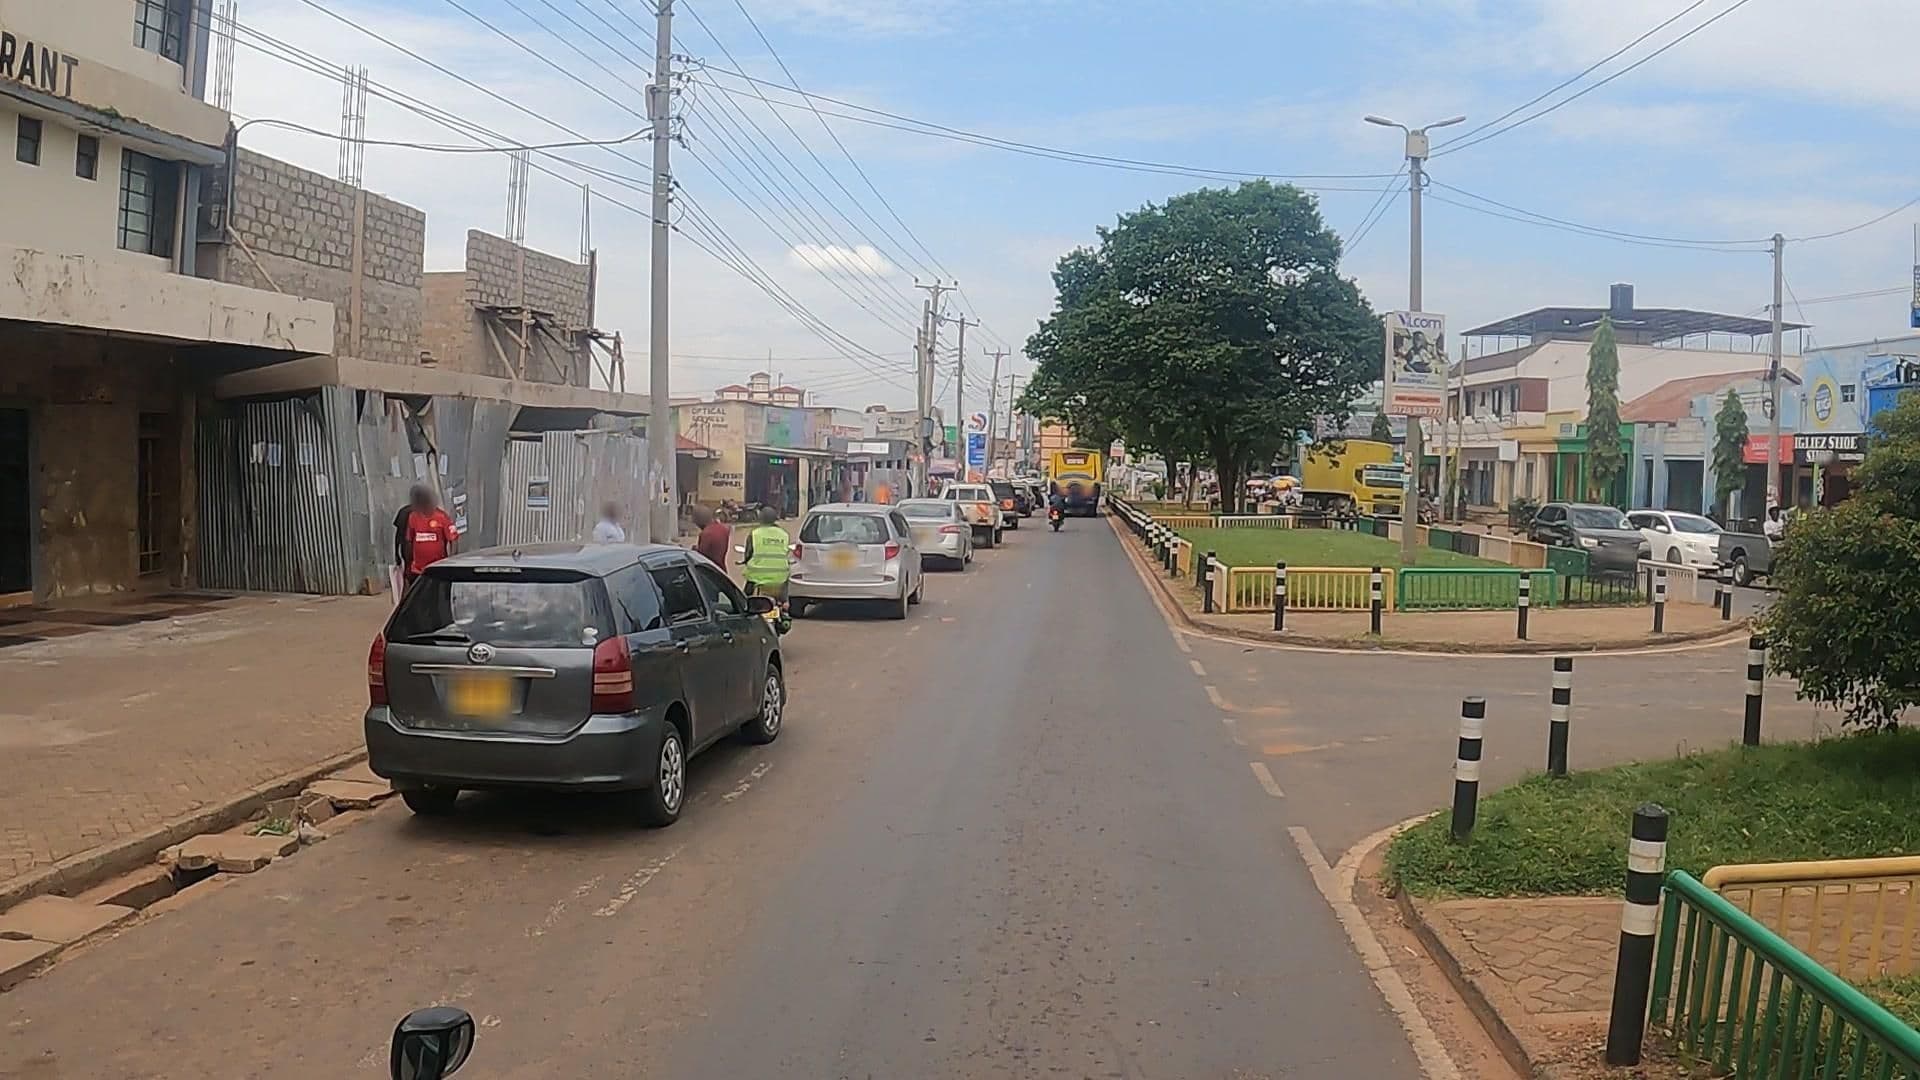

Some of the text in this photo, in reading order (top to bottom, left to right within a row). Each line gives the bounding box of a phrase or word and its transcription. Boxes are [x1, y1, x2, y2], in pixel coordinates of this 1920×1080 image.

[0, 30, 79, 97] RANT
[691, 407, 727, 415] OPTICAL
[1828, 435, 1858, 450] SHOE
